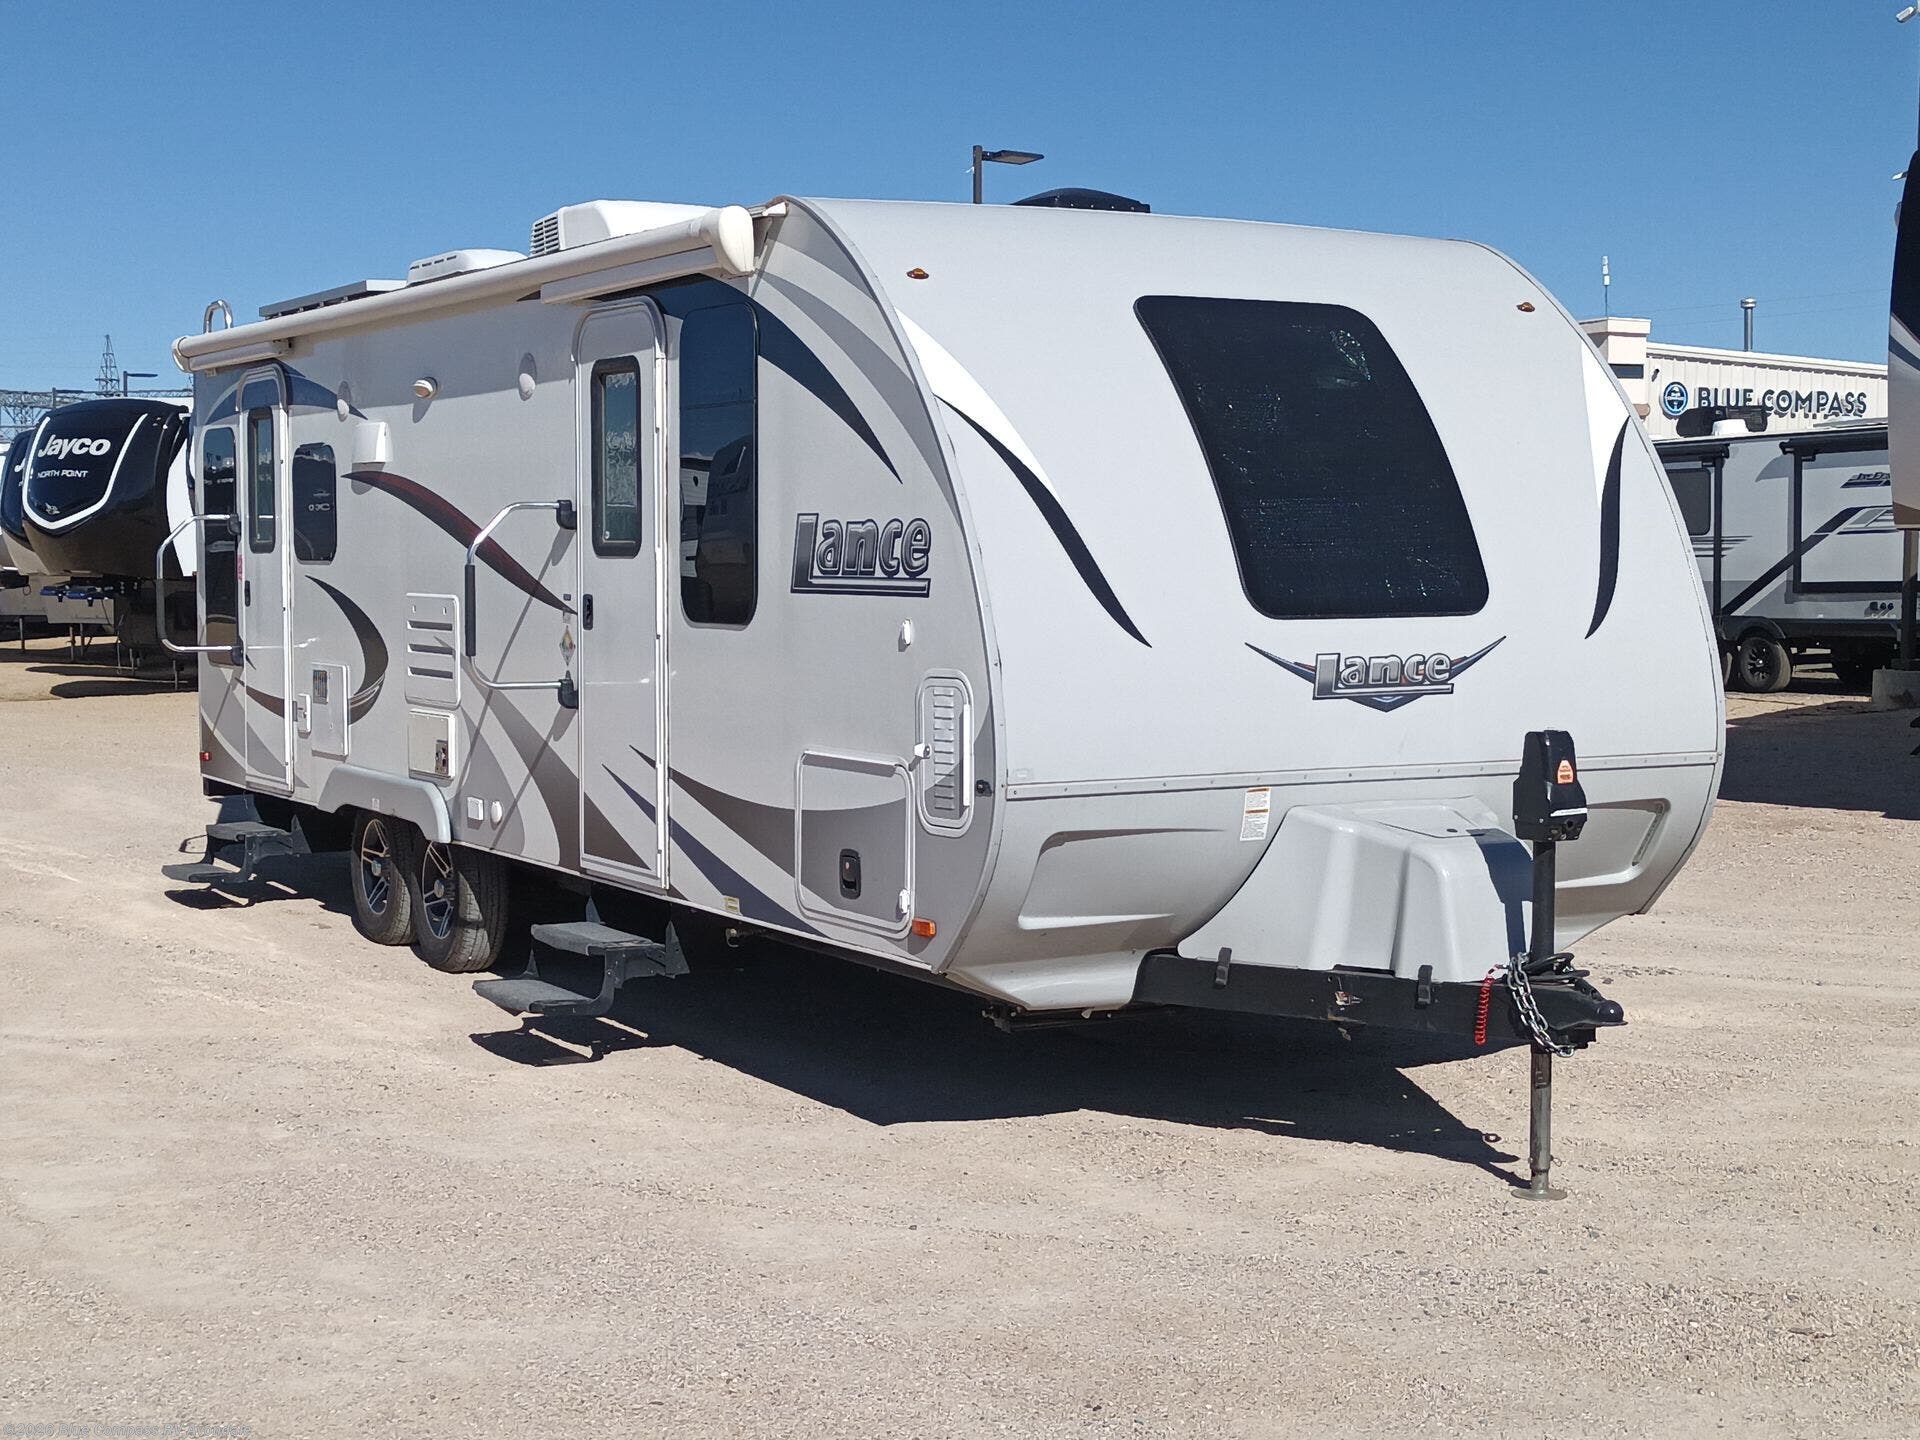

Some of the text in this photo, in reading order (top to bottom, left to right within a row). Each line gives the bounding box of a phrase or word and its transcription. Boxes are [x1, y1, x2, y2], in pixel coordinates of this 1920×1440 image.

[1699, 387, 1867, 414] BLUE COMPASS
[37, 434, 111, 460] Jayco
[60, 469, 88, 478] POINT
[790, 512, 932, 598] Lance
[1312, 652, 1454, 700] Lance
